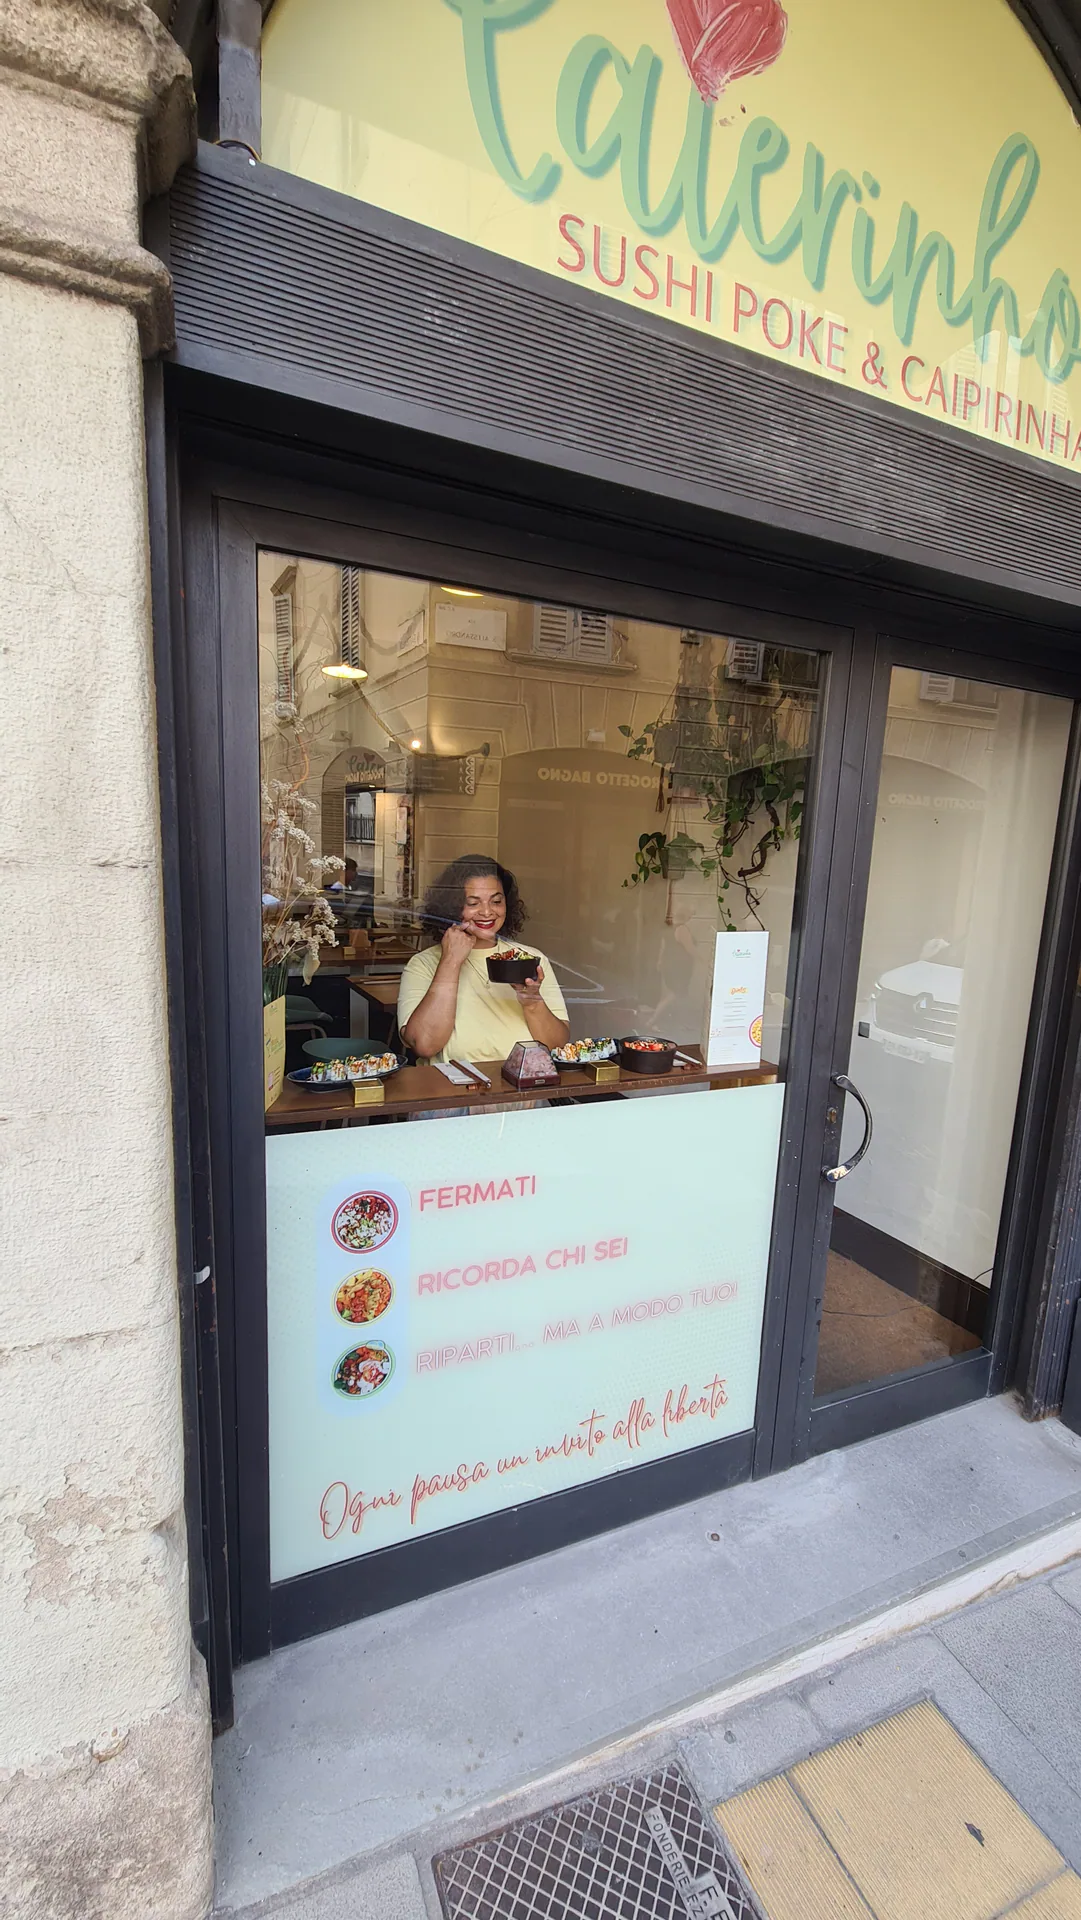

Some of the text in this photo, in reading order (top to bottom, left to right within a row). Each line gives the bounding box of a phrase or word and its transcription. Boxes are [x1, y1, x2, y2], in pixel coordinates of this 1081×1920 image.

[557, 213, 713, 323] SUSHI
[732, 282, 849, 373] POKE
[861, 341, 888, 389] &
[419, 1175, 537, 1212] FERMATI
[417, 1237, 629, 1296] RICORDA CHI SEI
[416, 1282, 738, 1373] RIPARTI... MA A MODO TUO!
[319, 1373, 730, 1541] Ogni pausa un invito alla libertà
